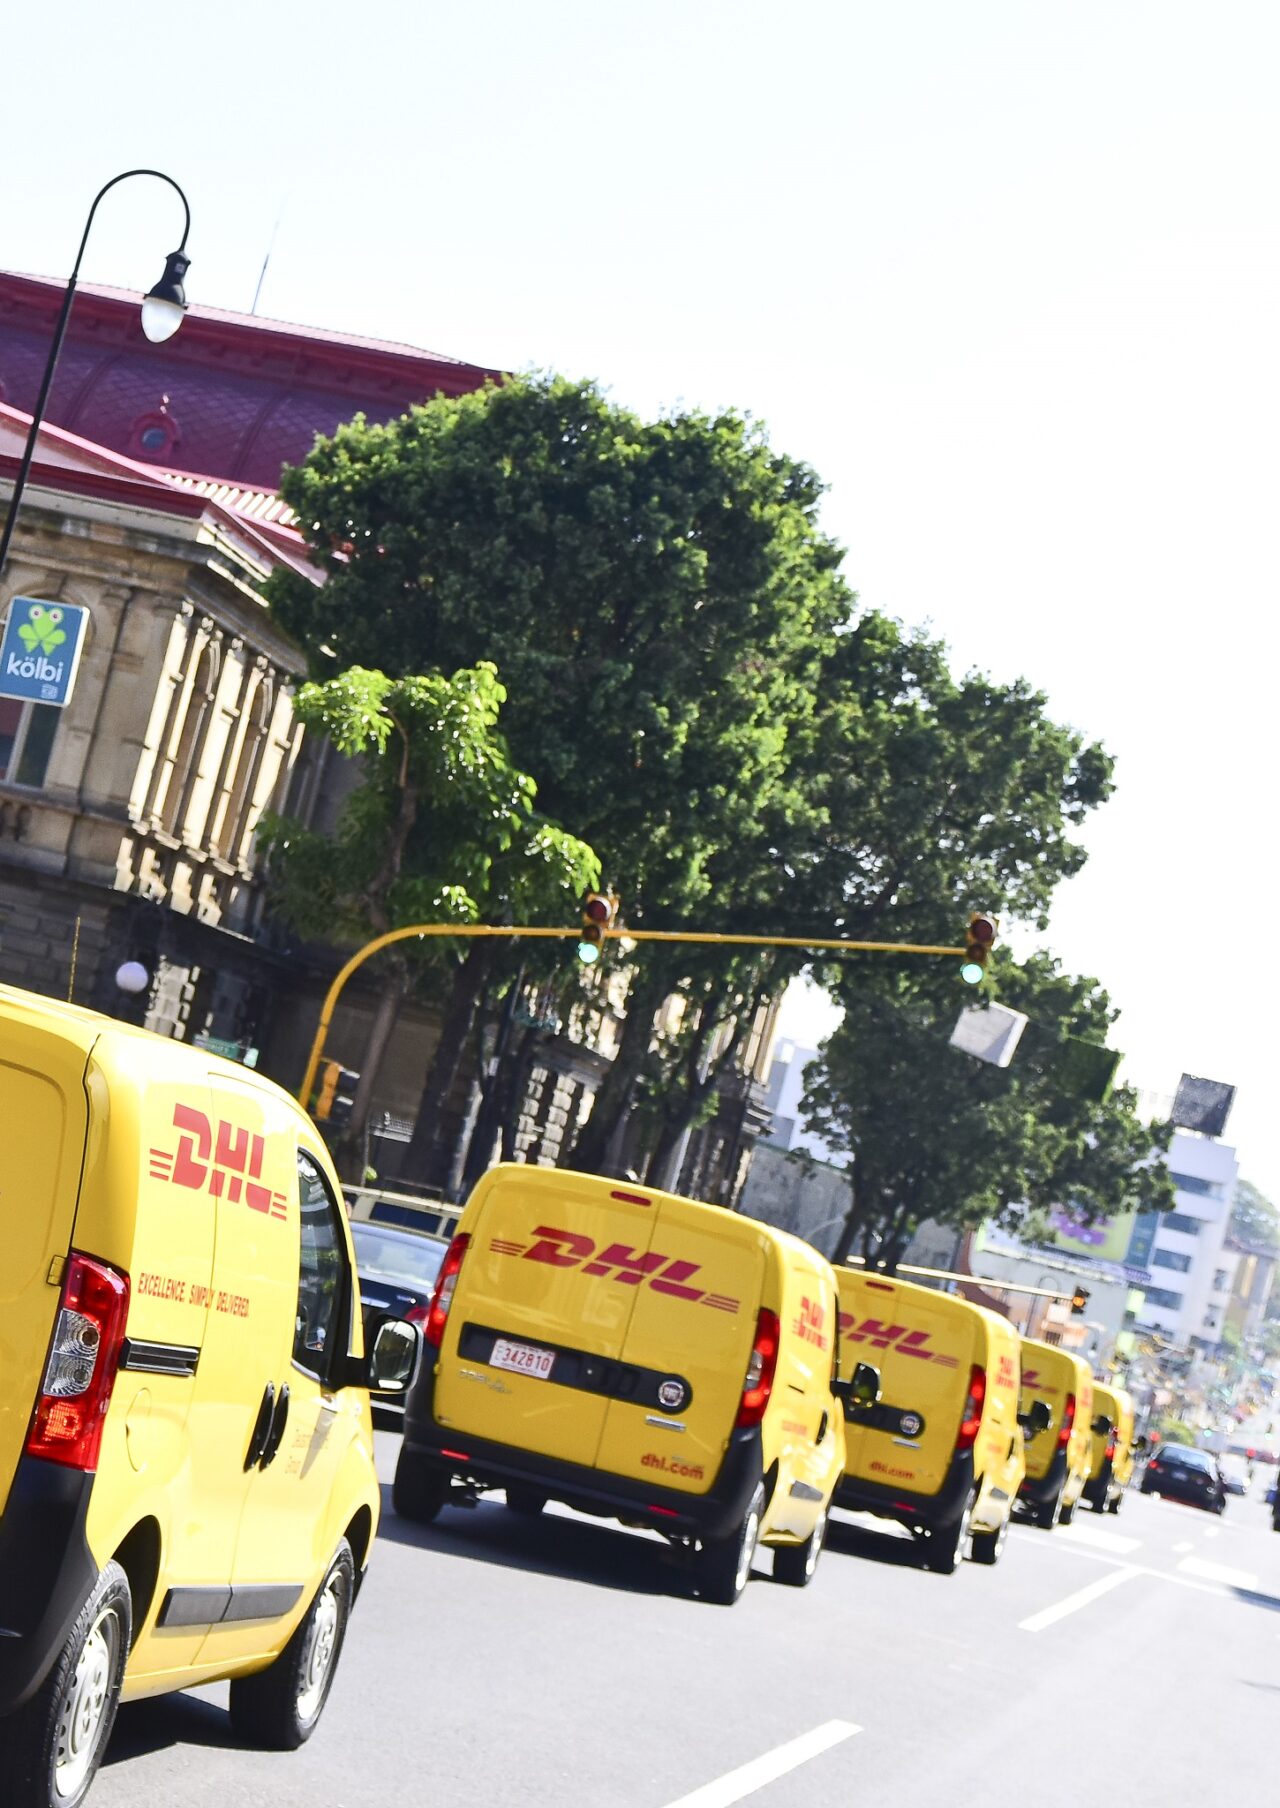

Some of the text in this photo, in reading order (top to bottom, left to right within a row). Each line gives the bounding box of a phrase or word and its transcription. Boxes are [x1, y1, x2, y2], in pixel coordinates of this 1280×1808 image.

[6, 651, 64, 683] kölbi
[172, 1102, 272, 1215] DHL
[522, 1225, 706, 1302] DHL
[502, 1347, 550, 1372] 342810
[640, 1453, 705, 1480] dhl.com
